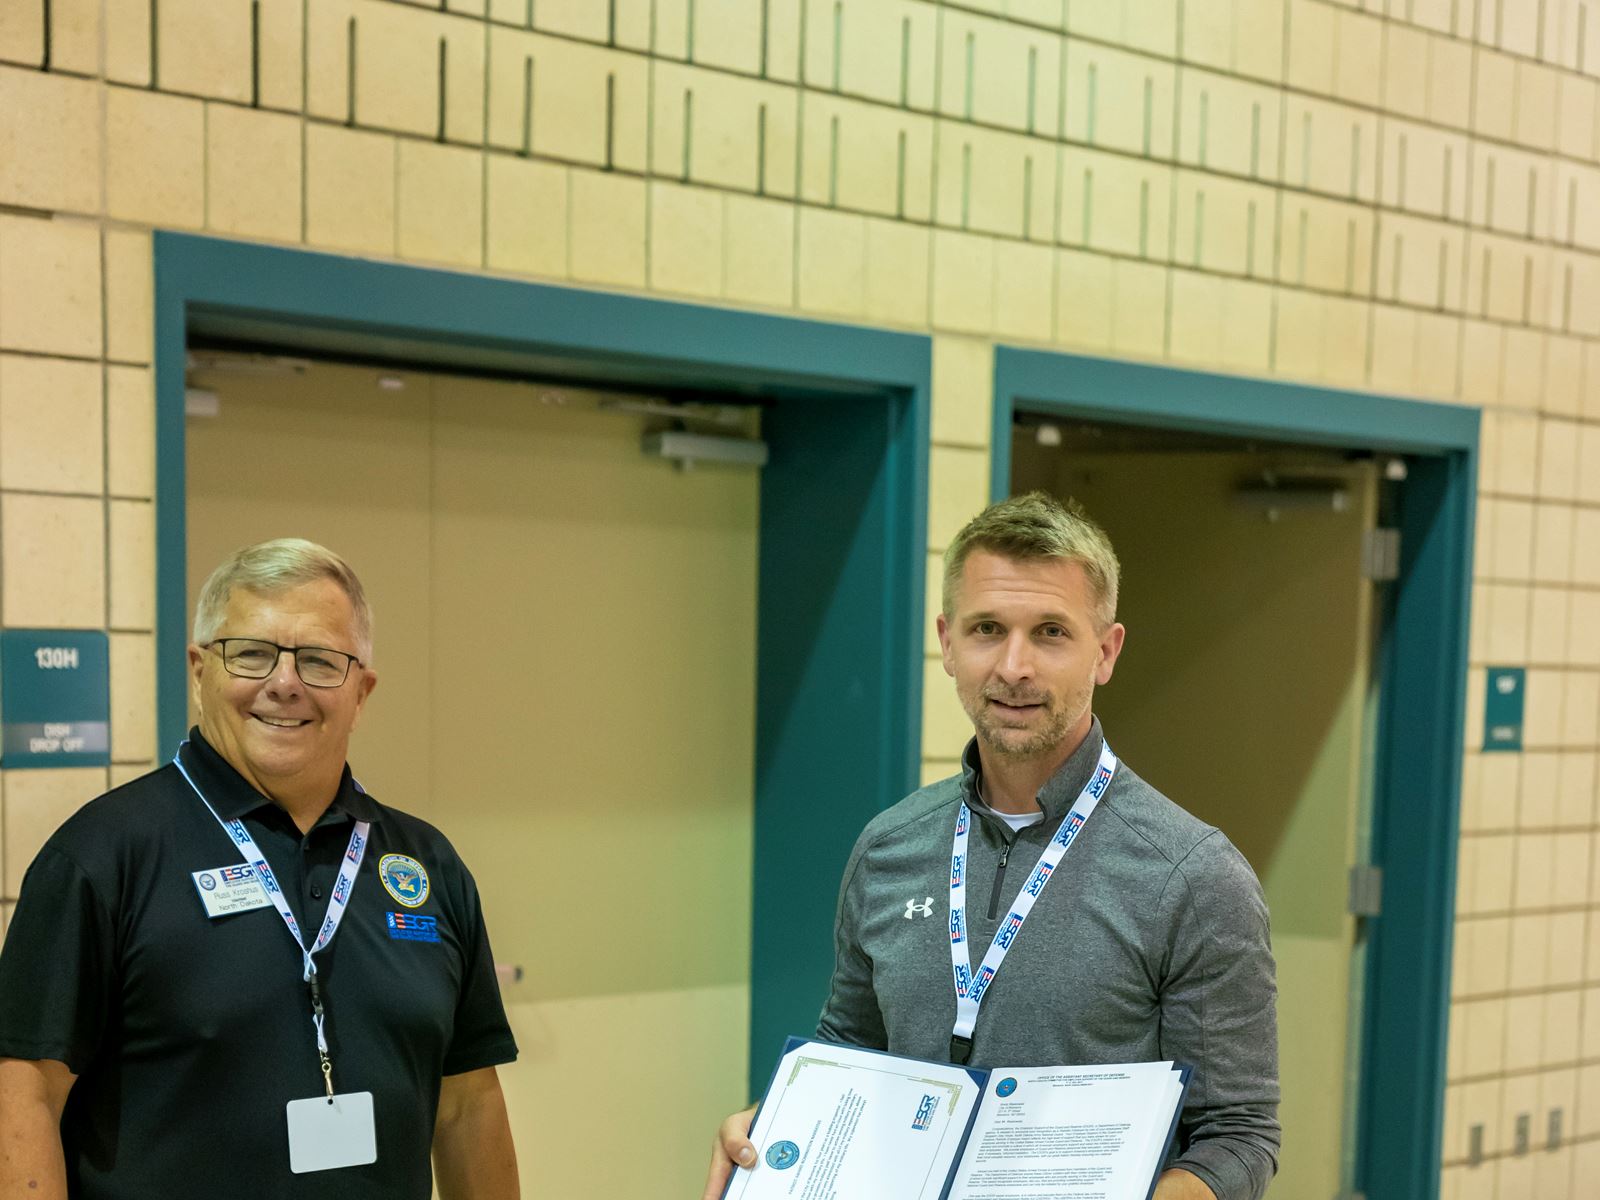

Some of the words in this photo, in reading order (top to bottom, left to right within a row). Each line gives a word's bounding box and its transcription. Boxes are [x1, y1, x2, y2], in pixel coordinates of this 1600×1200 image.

[35, 647, 79, 669] 130H
[1090, 767, 1112, 800] ESGR
[1059, 813, 1086, 848] ESGR
[256, 860, 280, 893] ESGR
[952, 855, 961, 888] ESGR
[1028, 862, 1054, 897] ESGR
[219, 903, 237, 911] North
[240, 899, 264, 908] Dakota
[386, 912, 437, 931] ESGR
[951, 909, 961, 944] ESGR
[998, 914, 1023, 950] ESGR
[971, 967, 995, 1003] ESGR
[912, 1094, 935, 1130] ESGR
